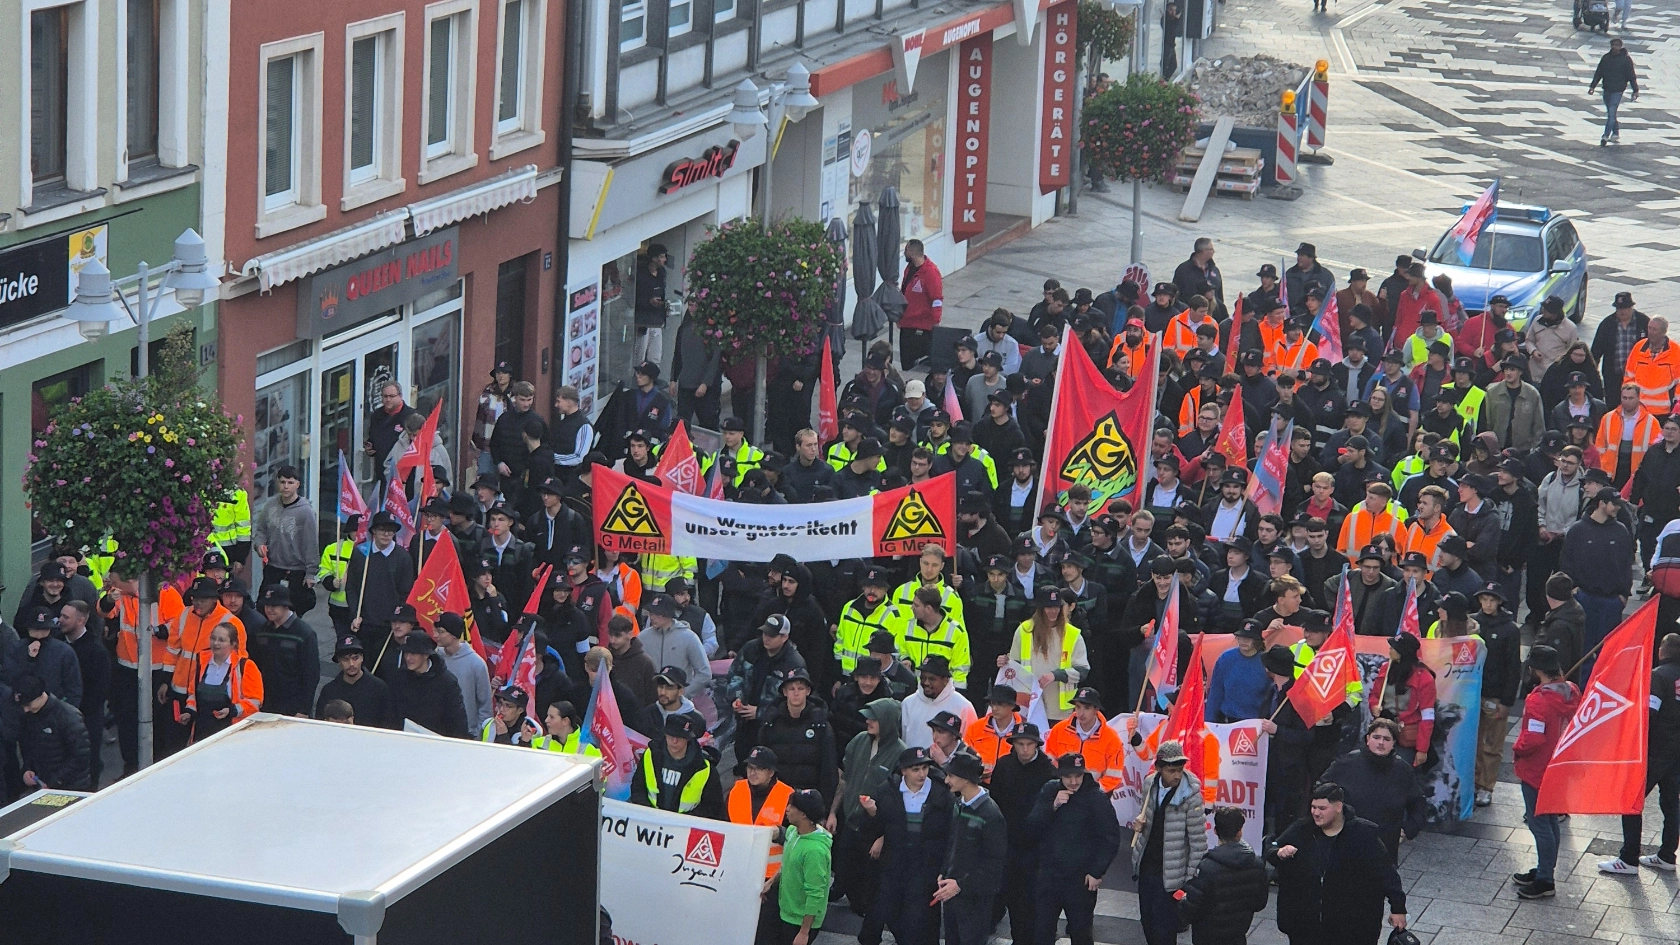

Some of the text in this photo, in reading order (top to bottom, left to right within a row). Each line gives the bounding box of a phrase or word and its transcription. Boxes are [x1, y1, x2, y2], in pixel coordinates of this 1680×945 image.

[943, 18, 981, 45] AUGENOPTIK
[1050, 13, 1068, 177] HÖRGERÄTE
[963, 47, 983, 223] AUGENOPTIK
[346, 240, 452, 301] QUEEN NAILS
[618, 535, 666, 552] Metall
[879, 542, 897, 553] IG
[1216, 779, 1258, 806] ADT
[602, 816, 674, 849] nd wir
